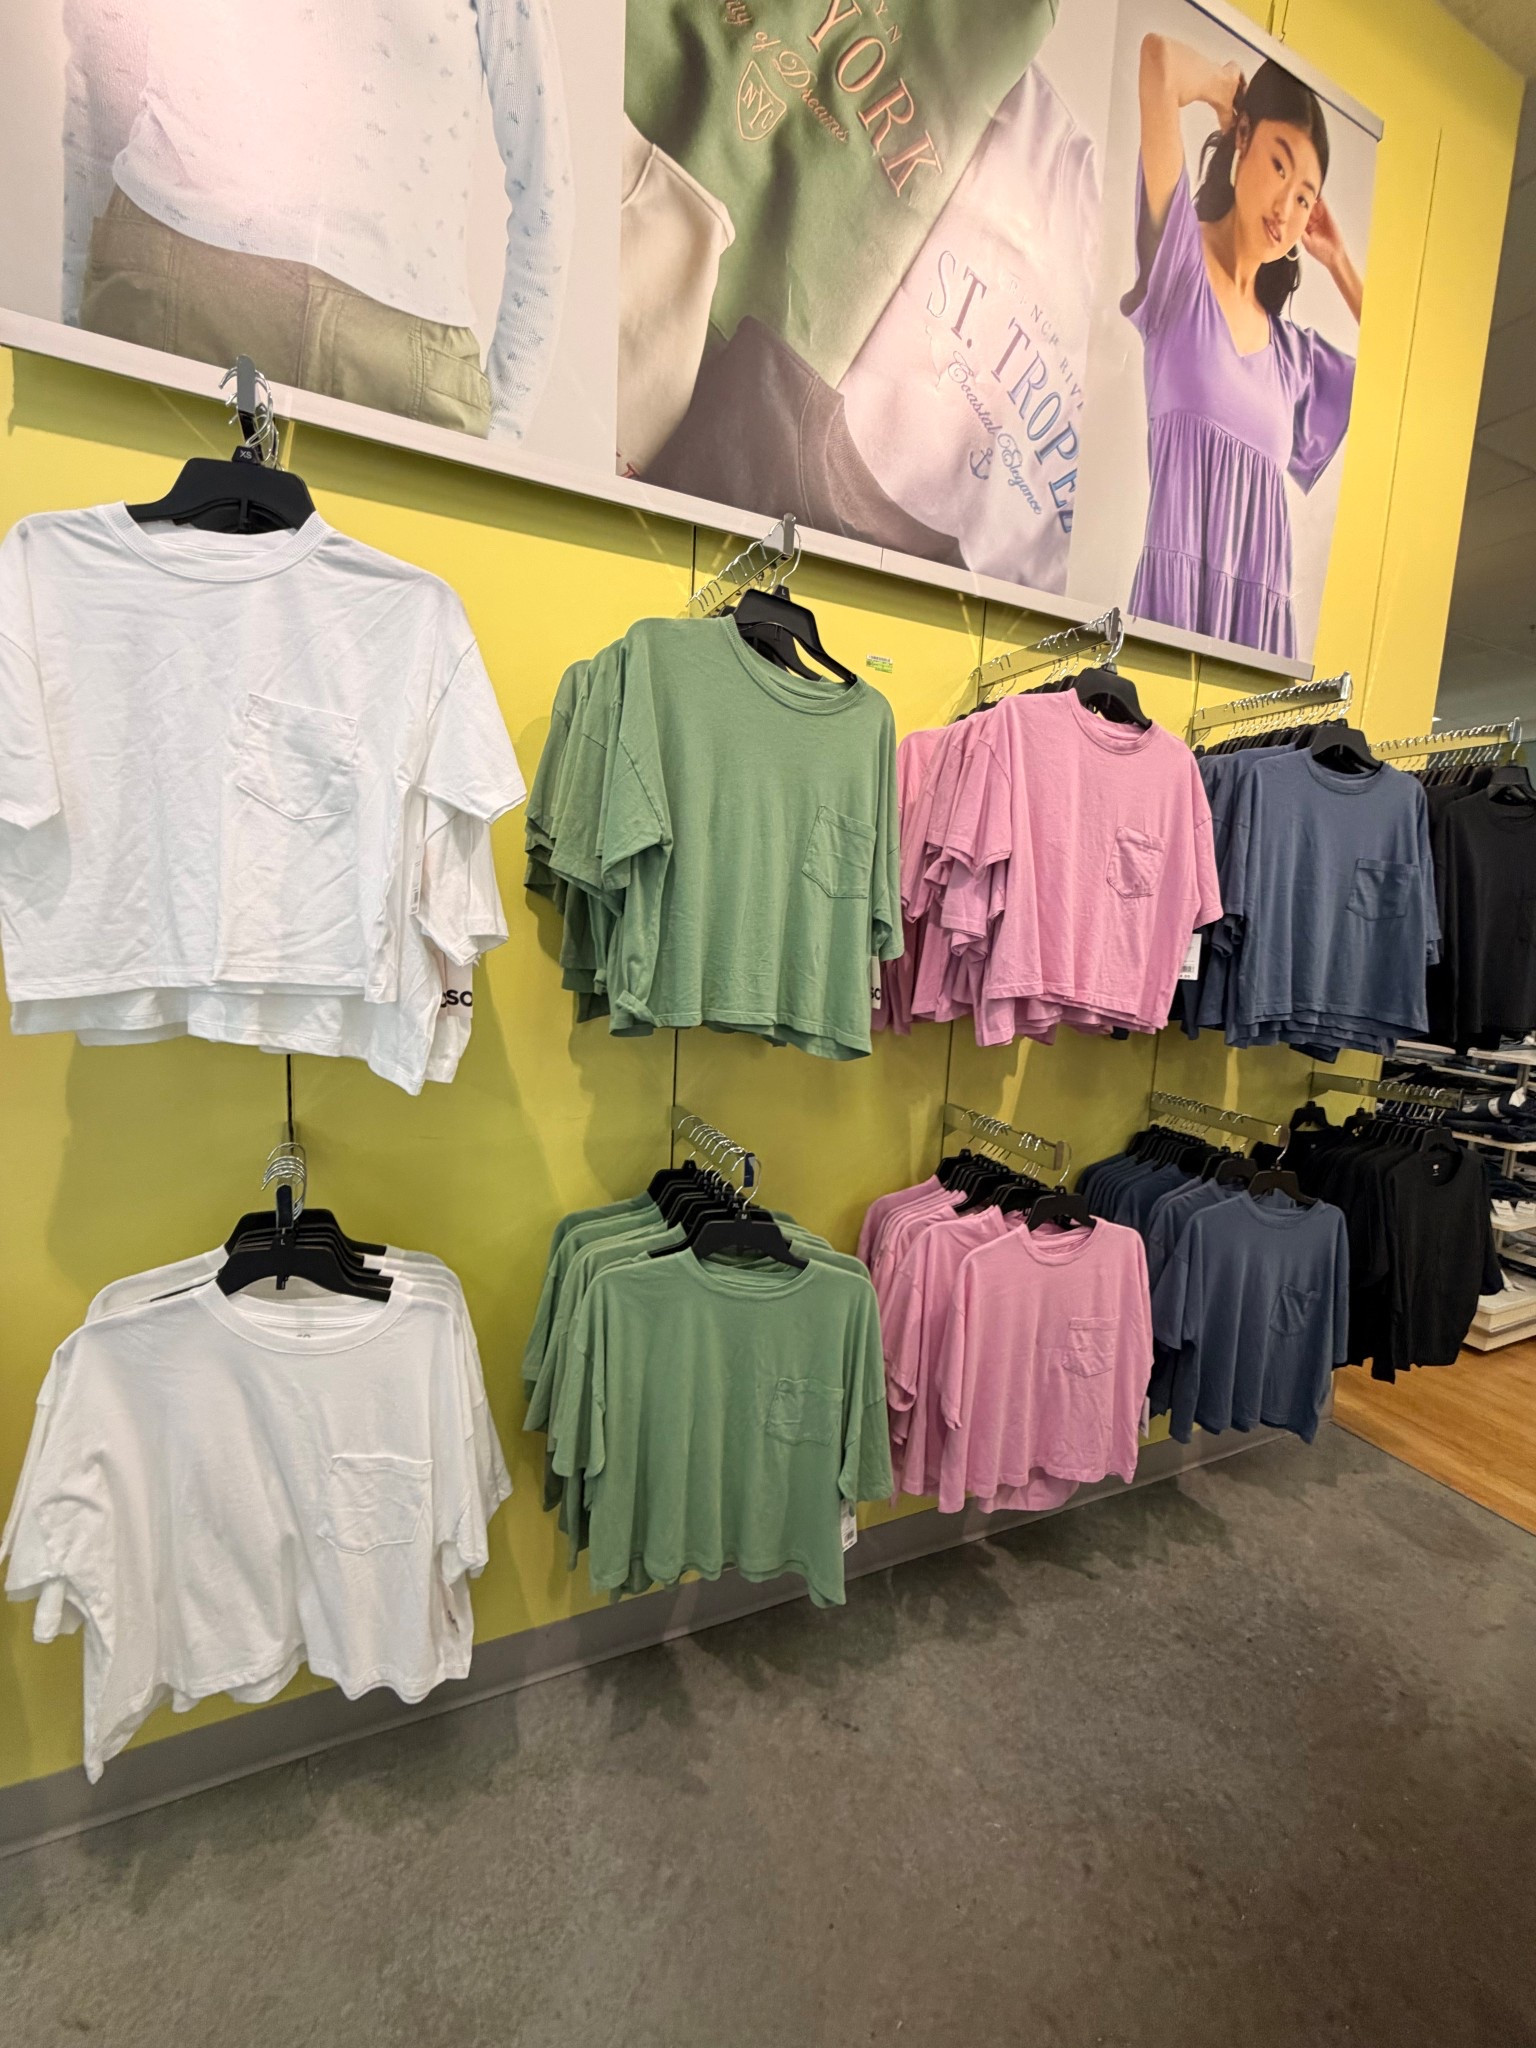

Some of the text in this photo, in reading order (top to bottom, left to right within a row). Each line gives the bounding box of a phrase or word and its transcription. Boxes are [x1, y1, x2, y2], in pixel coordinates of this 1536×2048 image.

[742, 80, 775, 130] NYC
[752, 31, 781, 52] of
[773, 51, 848, 141] Dreams
[807, 0, 942, 197] YORK
[926, 250, 987, 349] ST.
[240, 449, 253, 460] XS
[948, 350, 1042, 515] Coastal Elegance
